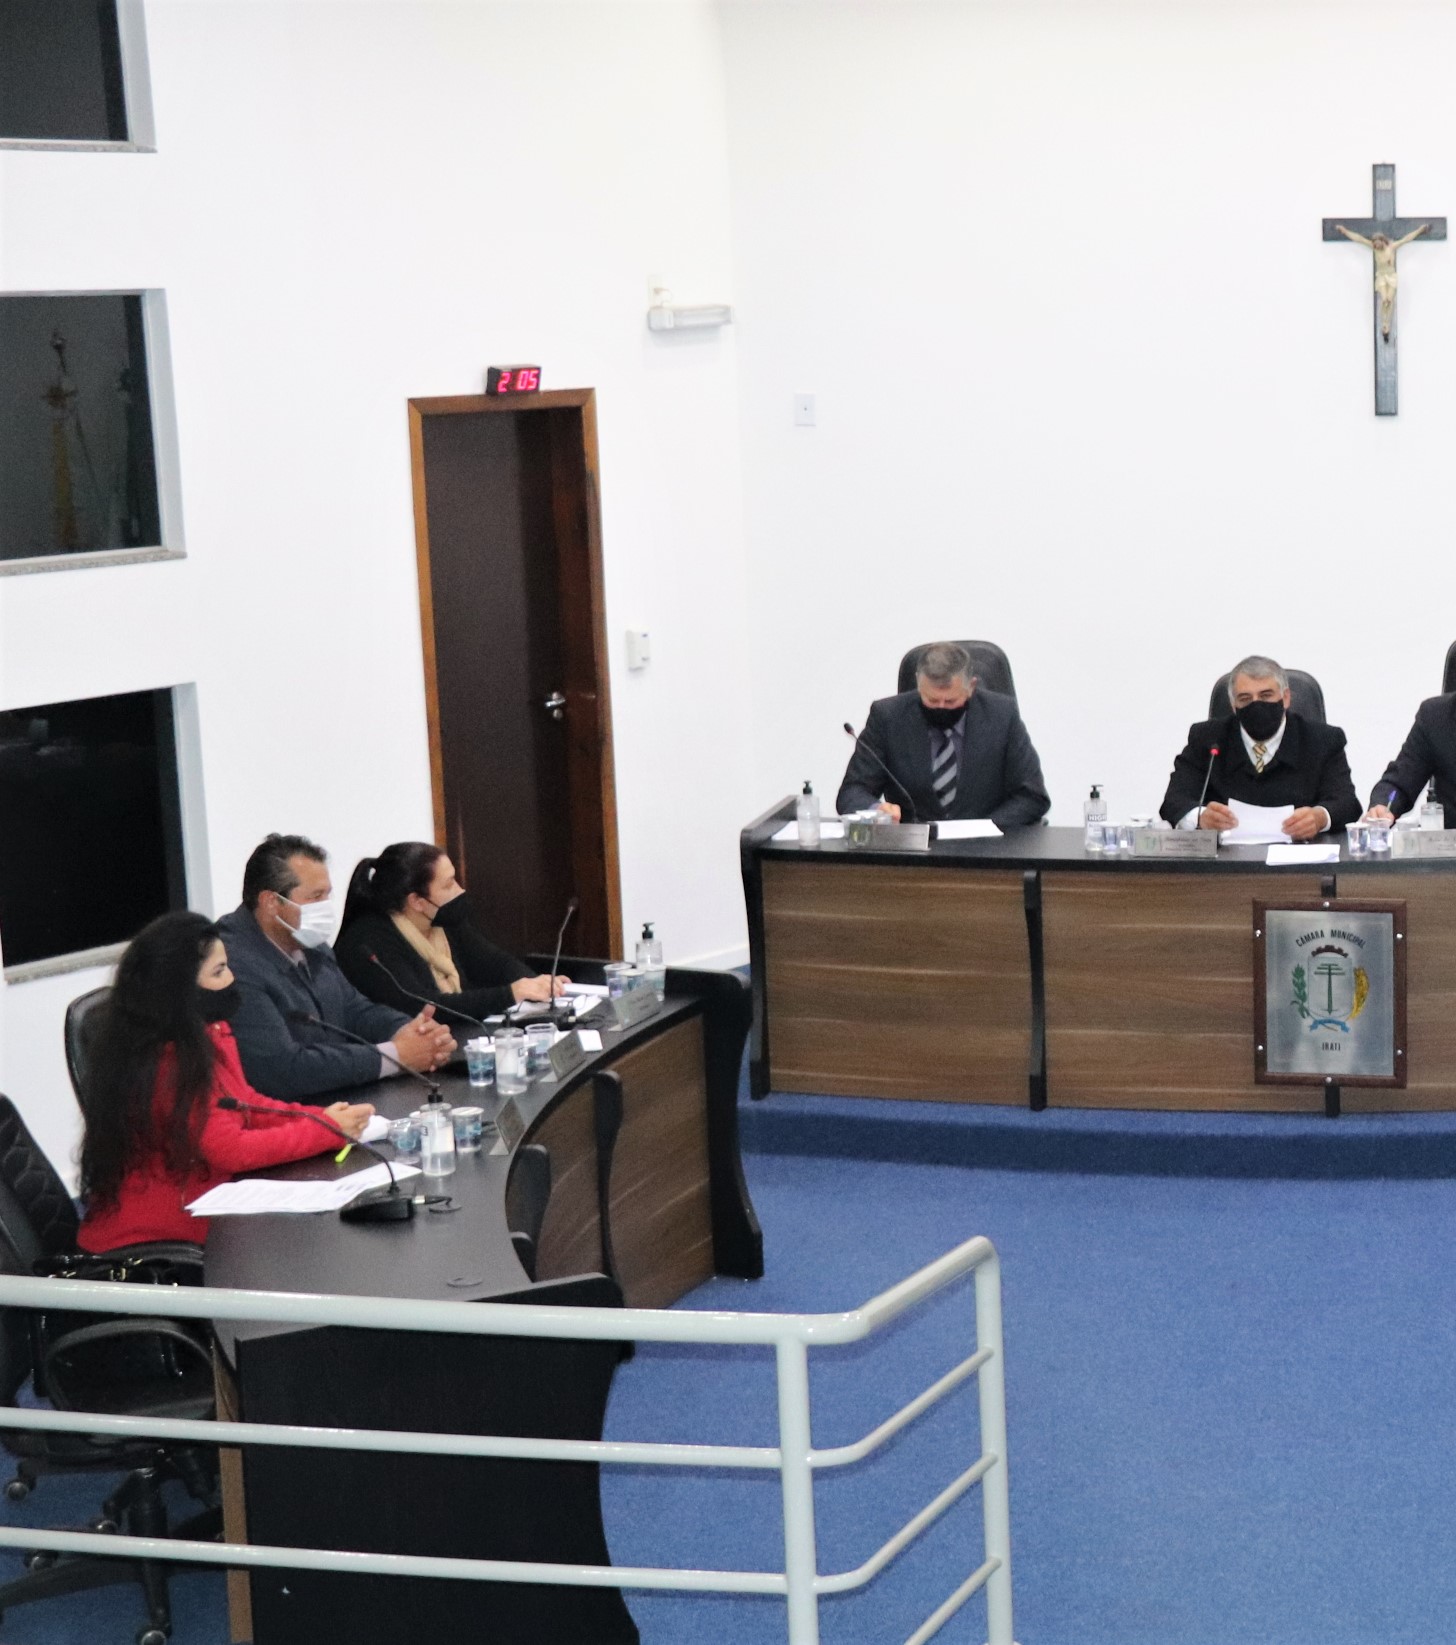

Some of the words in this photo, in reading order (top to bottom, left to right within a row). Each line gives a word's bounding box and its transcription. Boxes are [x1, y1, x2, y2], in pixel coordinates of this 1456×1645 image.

[497, 372, 512, 393] 2
[516, 369, 539, 391] 05
[1330, 929, 1366, 949] MUNICIPAL
[1322, 1041, 1341, 1051] IRATI
